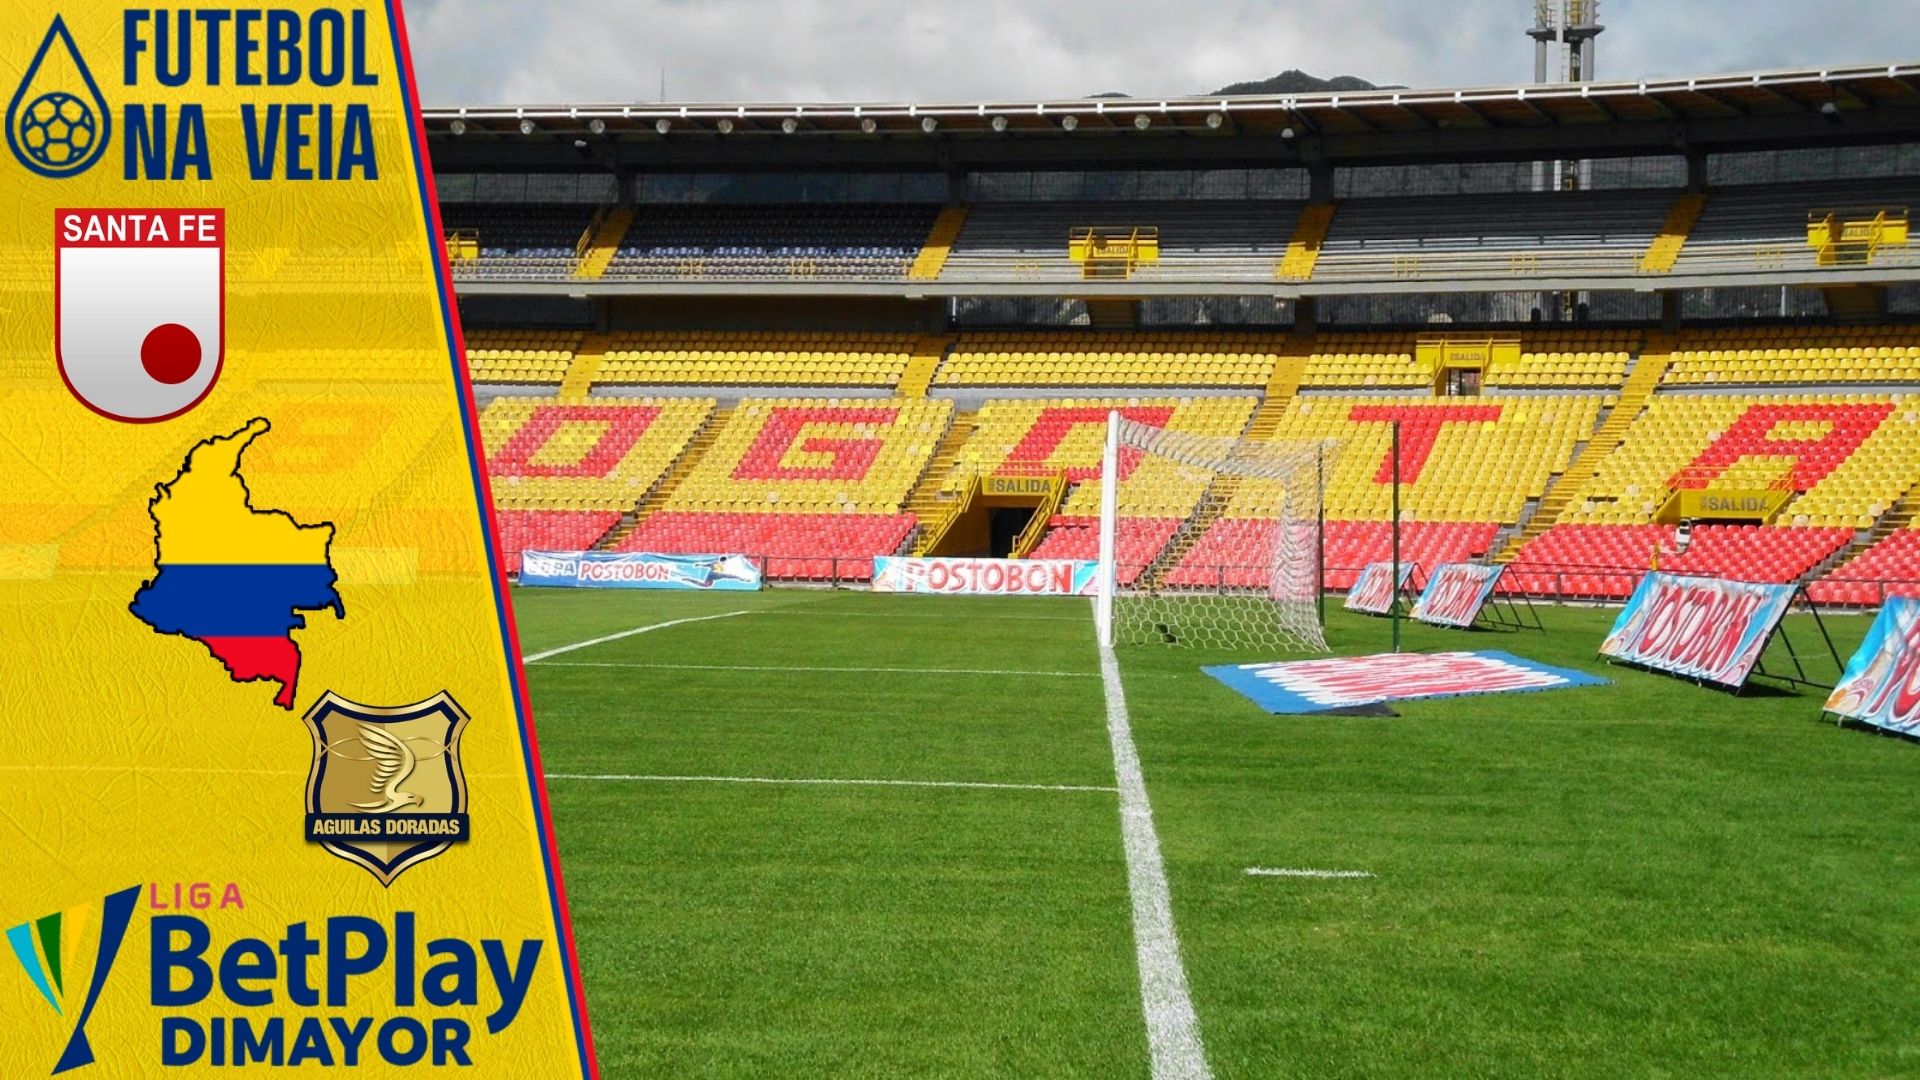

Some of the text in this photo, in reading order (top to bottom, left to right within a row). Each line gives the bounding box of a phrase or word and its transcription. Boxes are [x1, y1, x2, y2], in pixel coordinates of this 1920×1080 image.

[996, 479, 1051, 492] SALIDA
[1708, 496, 1769, 512] SALIDA
[580, 562, 669, 580] POSTOBON
